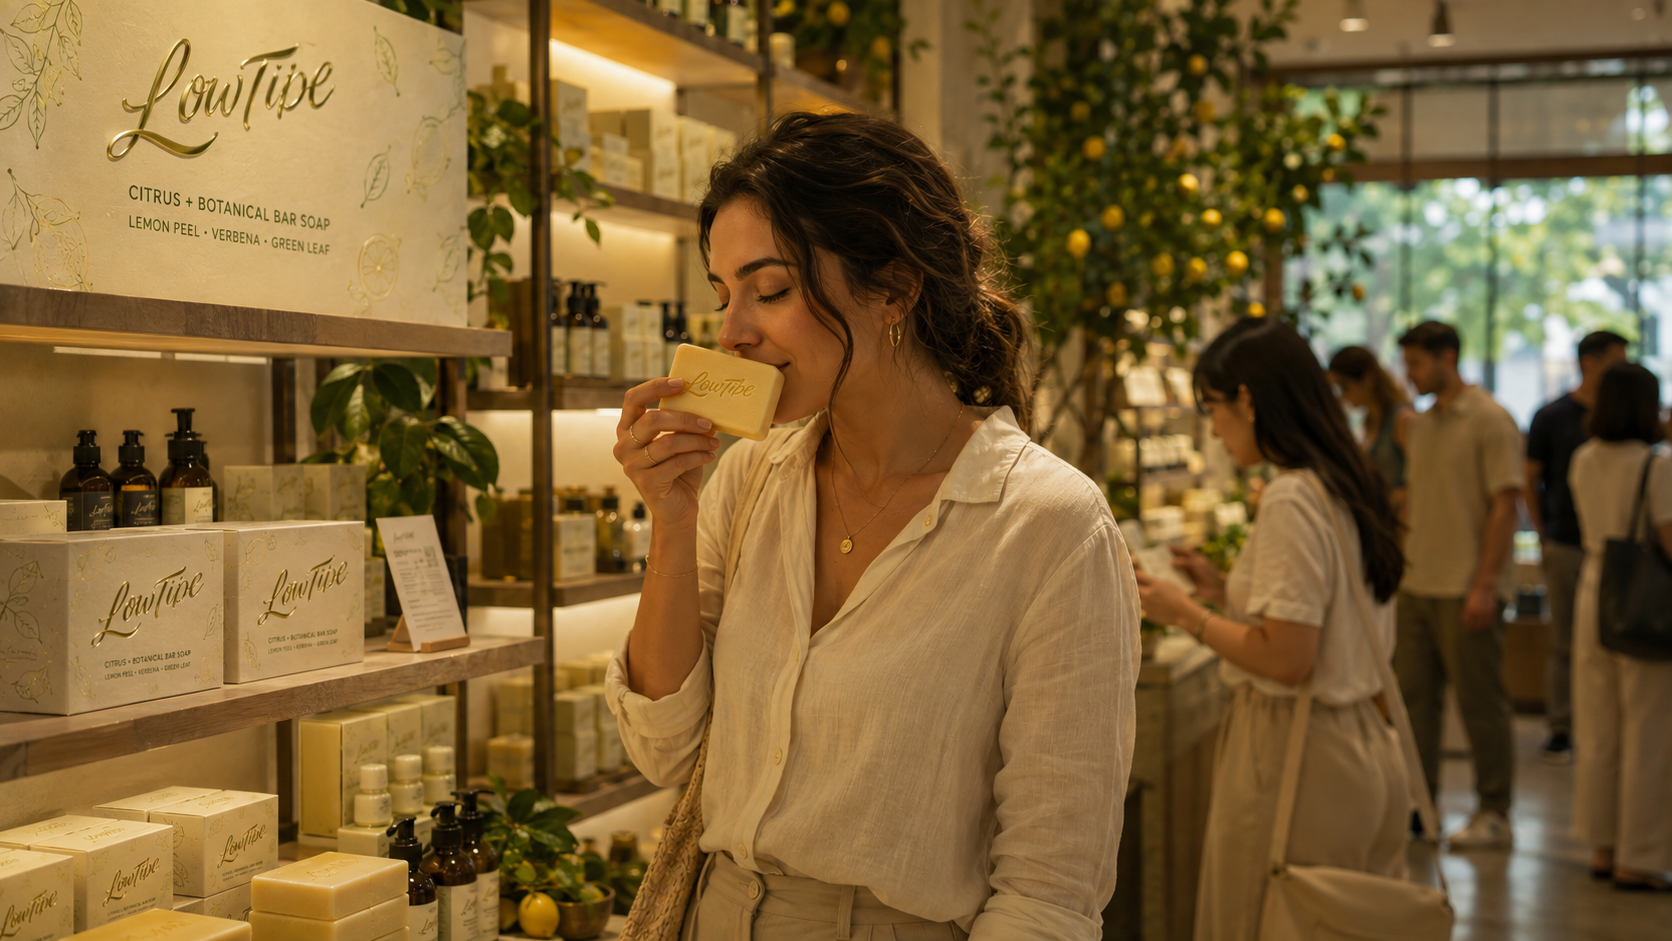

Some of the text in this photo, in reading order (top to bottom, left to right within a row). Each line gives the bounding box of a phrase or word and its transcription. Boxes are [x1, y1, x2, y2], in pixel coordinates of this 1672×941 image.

[129, 185, 330, 231] CITRUS + BOTANICAL BAR SOAP
[129, 215, 170, 233] LEMON
[174, 222, 200, 238] PEEL
[212, 228, 260, 246] VERBENA
[271, 237, 304, 252] GREEN
[307, 243, 330, 256] LEAF
[104, 659, 127, 669] CITRUS
